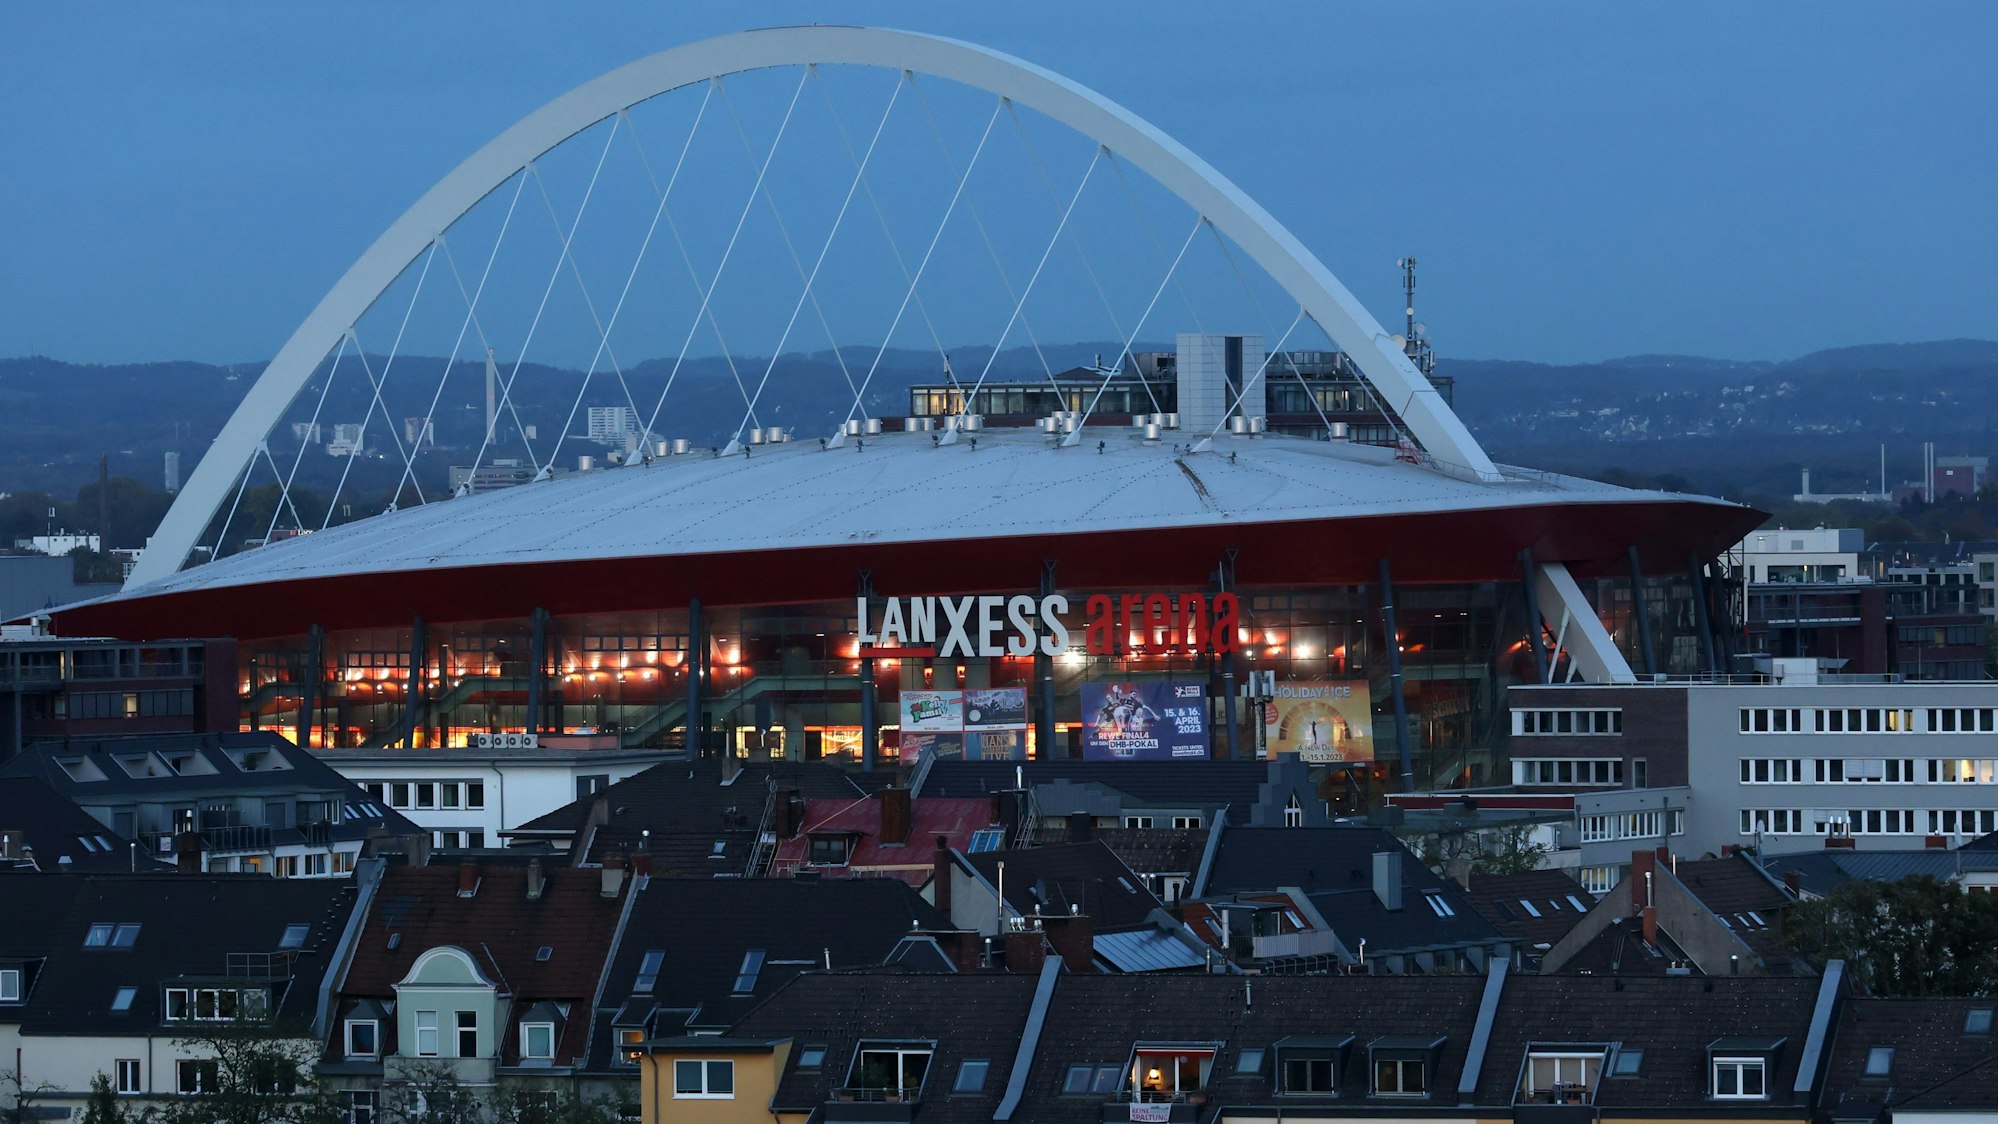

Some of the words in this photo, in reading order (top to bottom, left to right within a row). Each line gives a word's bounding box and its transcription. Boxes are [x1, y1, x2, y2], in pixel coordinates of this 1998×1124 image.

[857, 594, 1069, 658] LANXESS
[1085, 592, 1240, 656] arena
[1275, 686, 1324, 698] HOLIDAY
[1331, 686, 1351, 698] ICE
[920, 699, 948, 712] Kelly
[911, 707, 948, 723] Family
[1164, 708, 1176, 717] 15.
[1178, 708, 1186, 716] &
[1188, 707, 1200, 716] 16.
[1174, 717, 1201, 726] APRIL
[1178, 725, 1201, 734] 2023
[1098, 732, 1120, 740] REWE
[1122, 731, 1149, 739] FINAL4
[1110, 740, 1157, 748] DHB-POKAL
